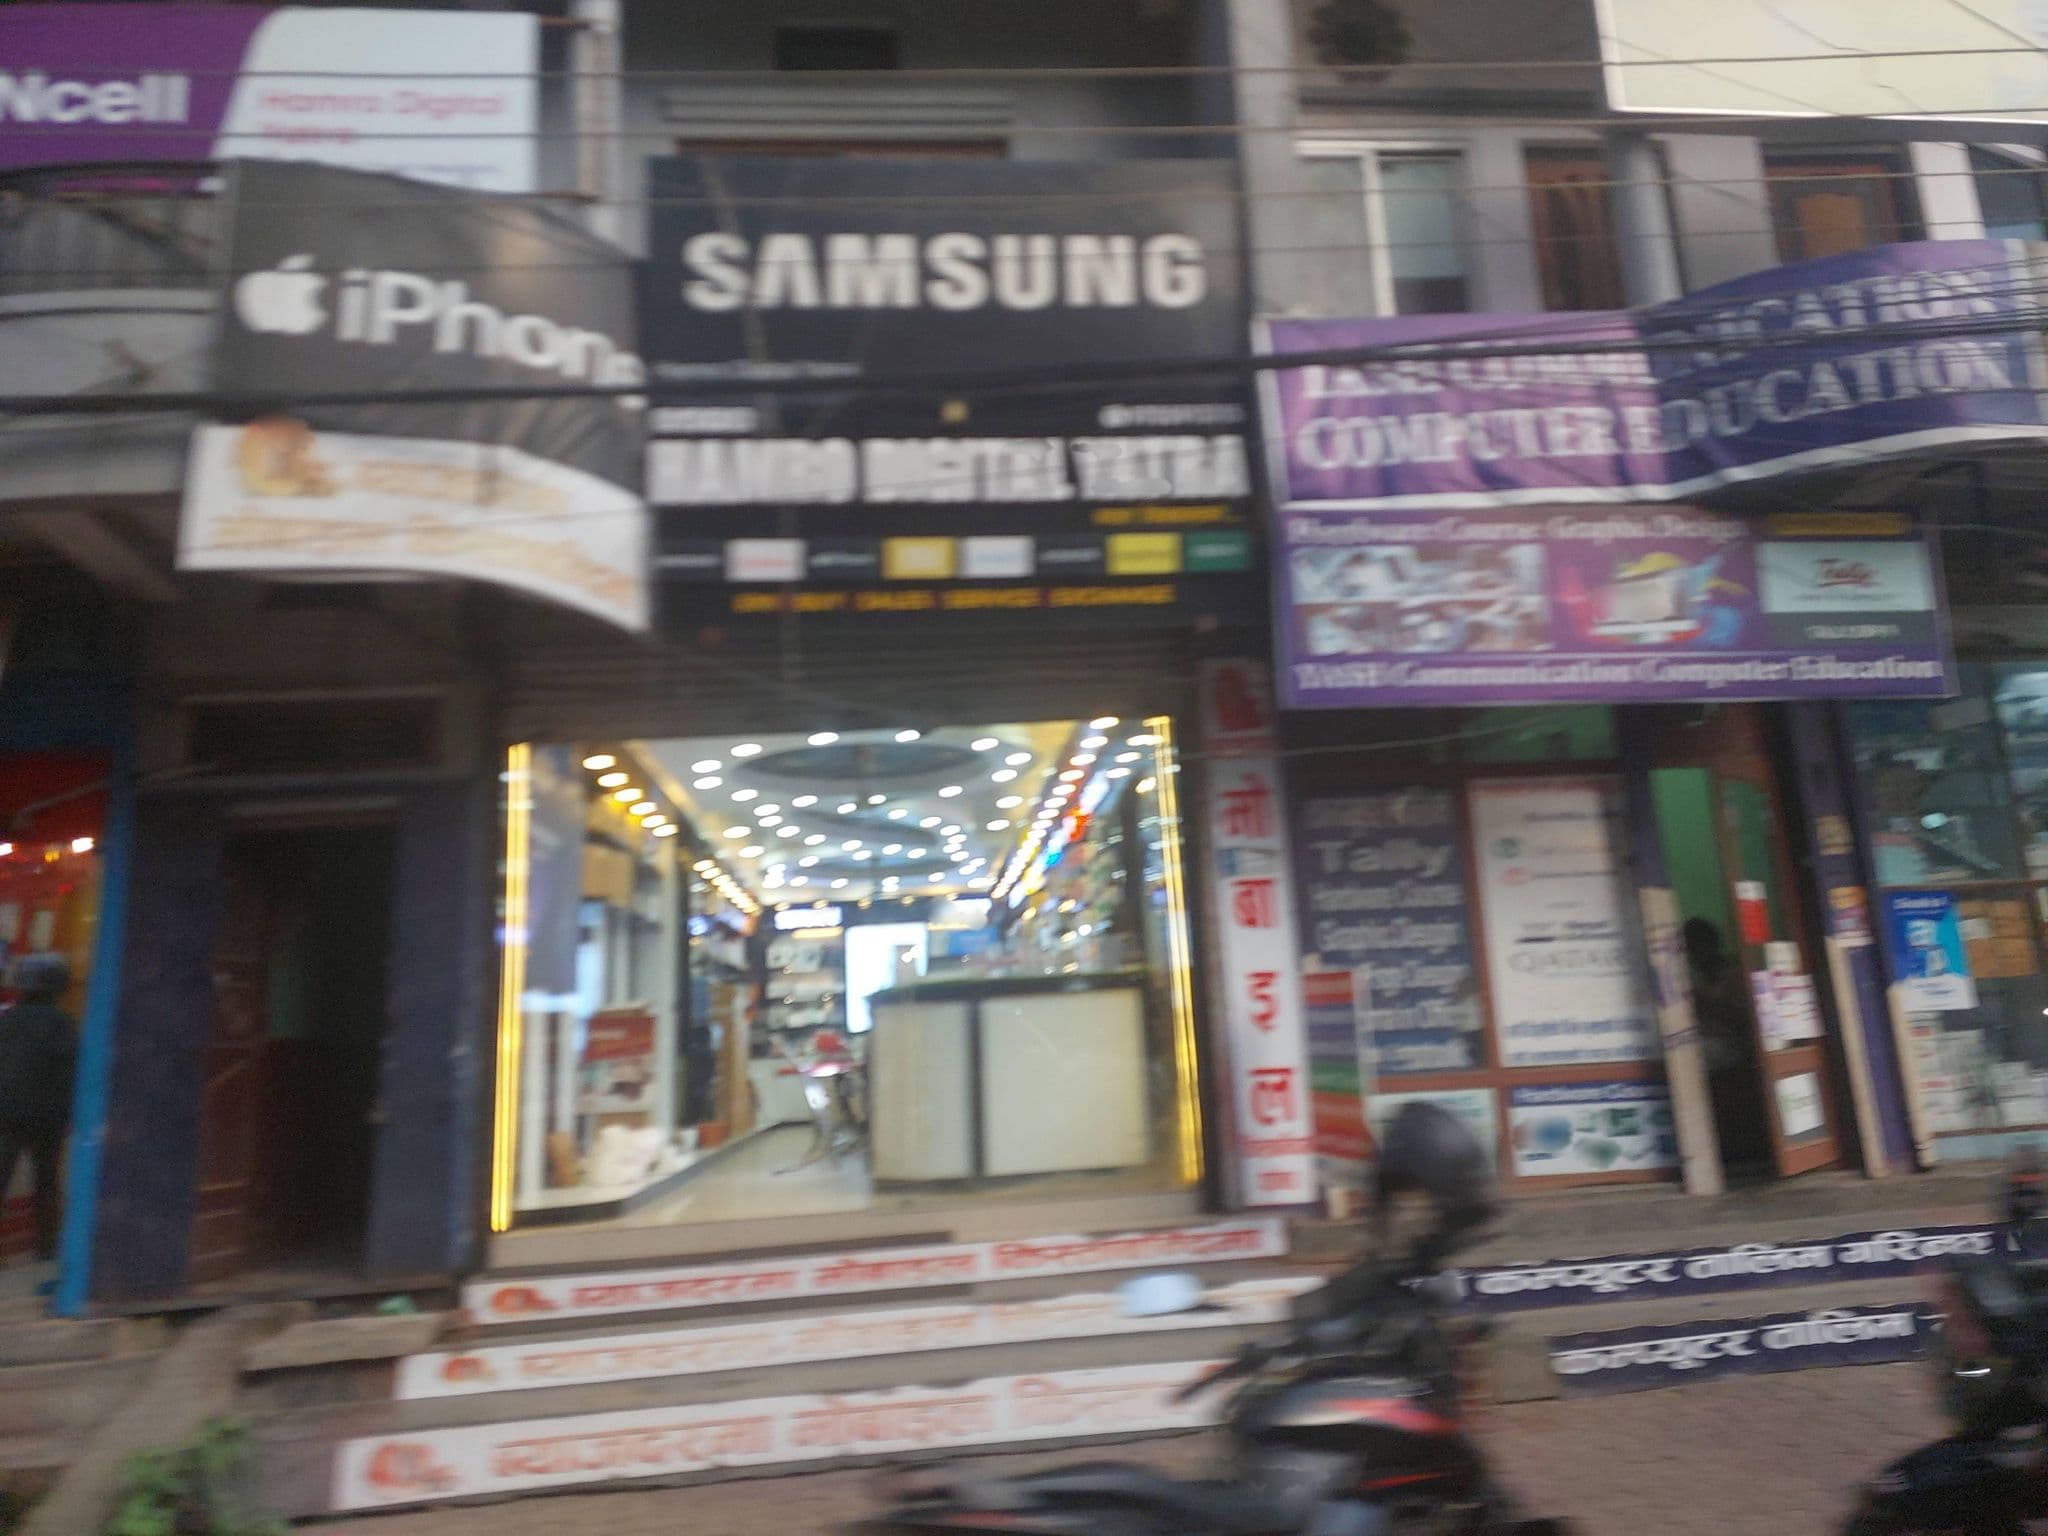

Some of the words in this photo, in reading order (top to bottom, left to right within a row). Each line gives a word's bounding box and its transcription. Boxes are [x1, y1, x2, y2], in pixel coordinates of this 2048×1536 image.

[0, 73, 190, 123] Ncell
[683, 231, 1206, 311] SAMSUNG
[336, 268, 649, 410] iPhone
[1299, 405, 1618, 470] COMPUTER
[1622, 339, 2014, 455] EDUCATION
[1391, 660, 1635, 687] Communication
[1638, 656, 1790, 690] Computer
[1790, 655, 1943, 682] Education
